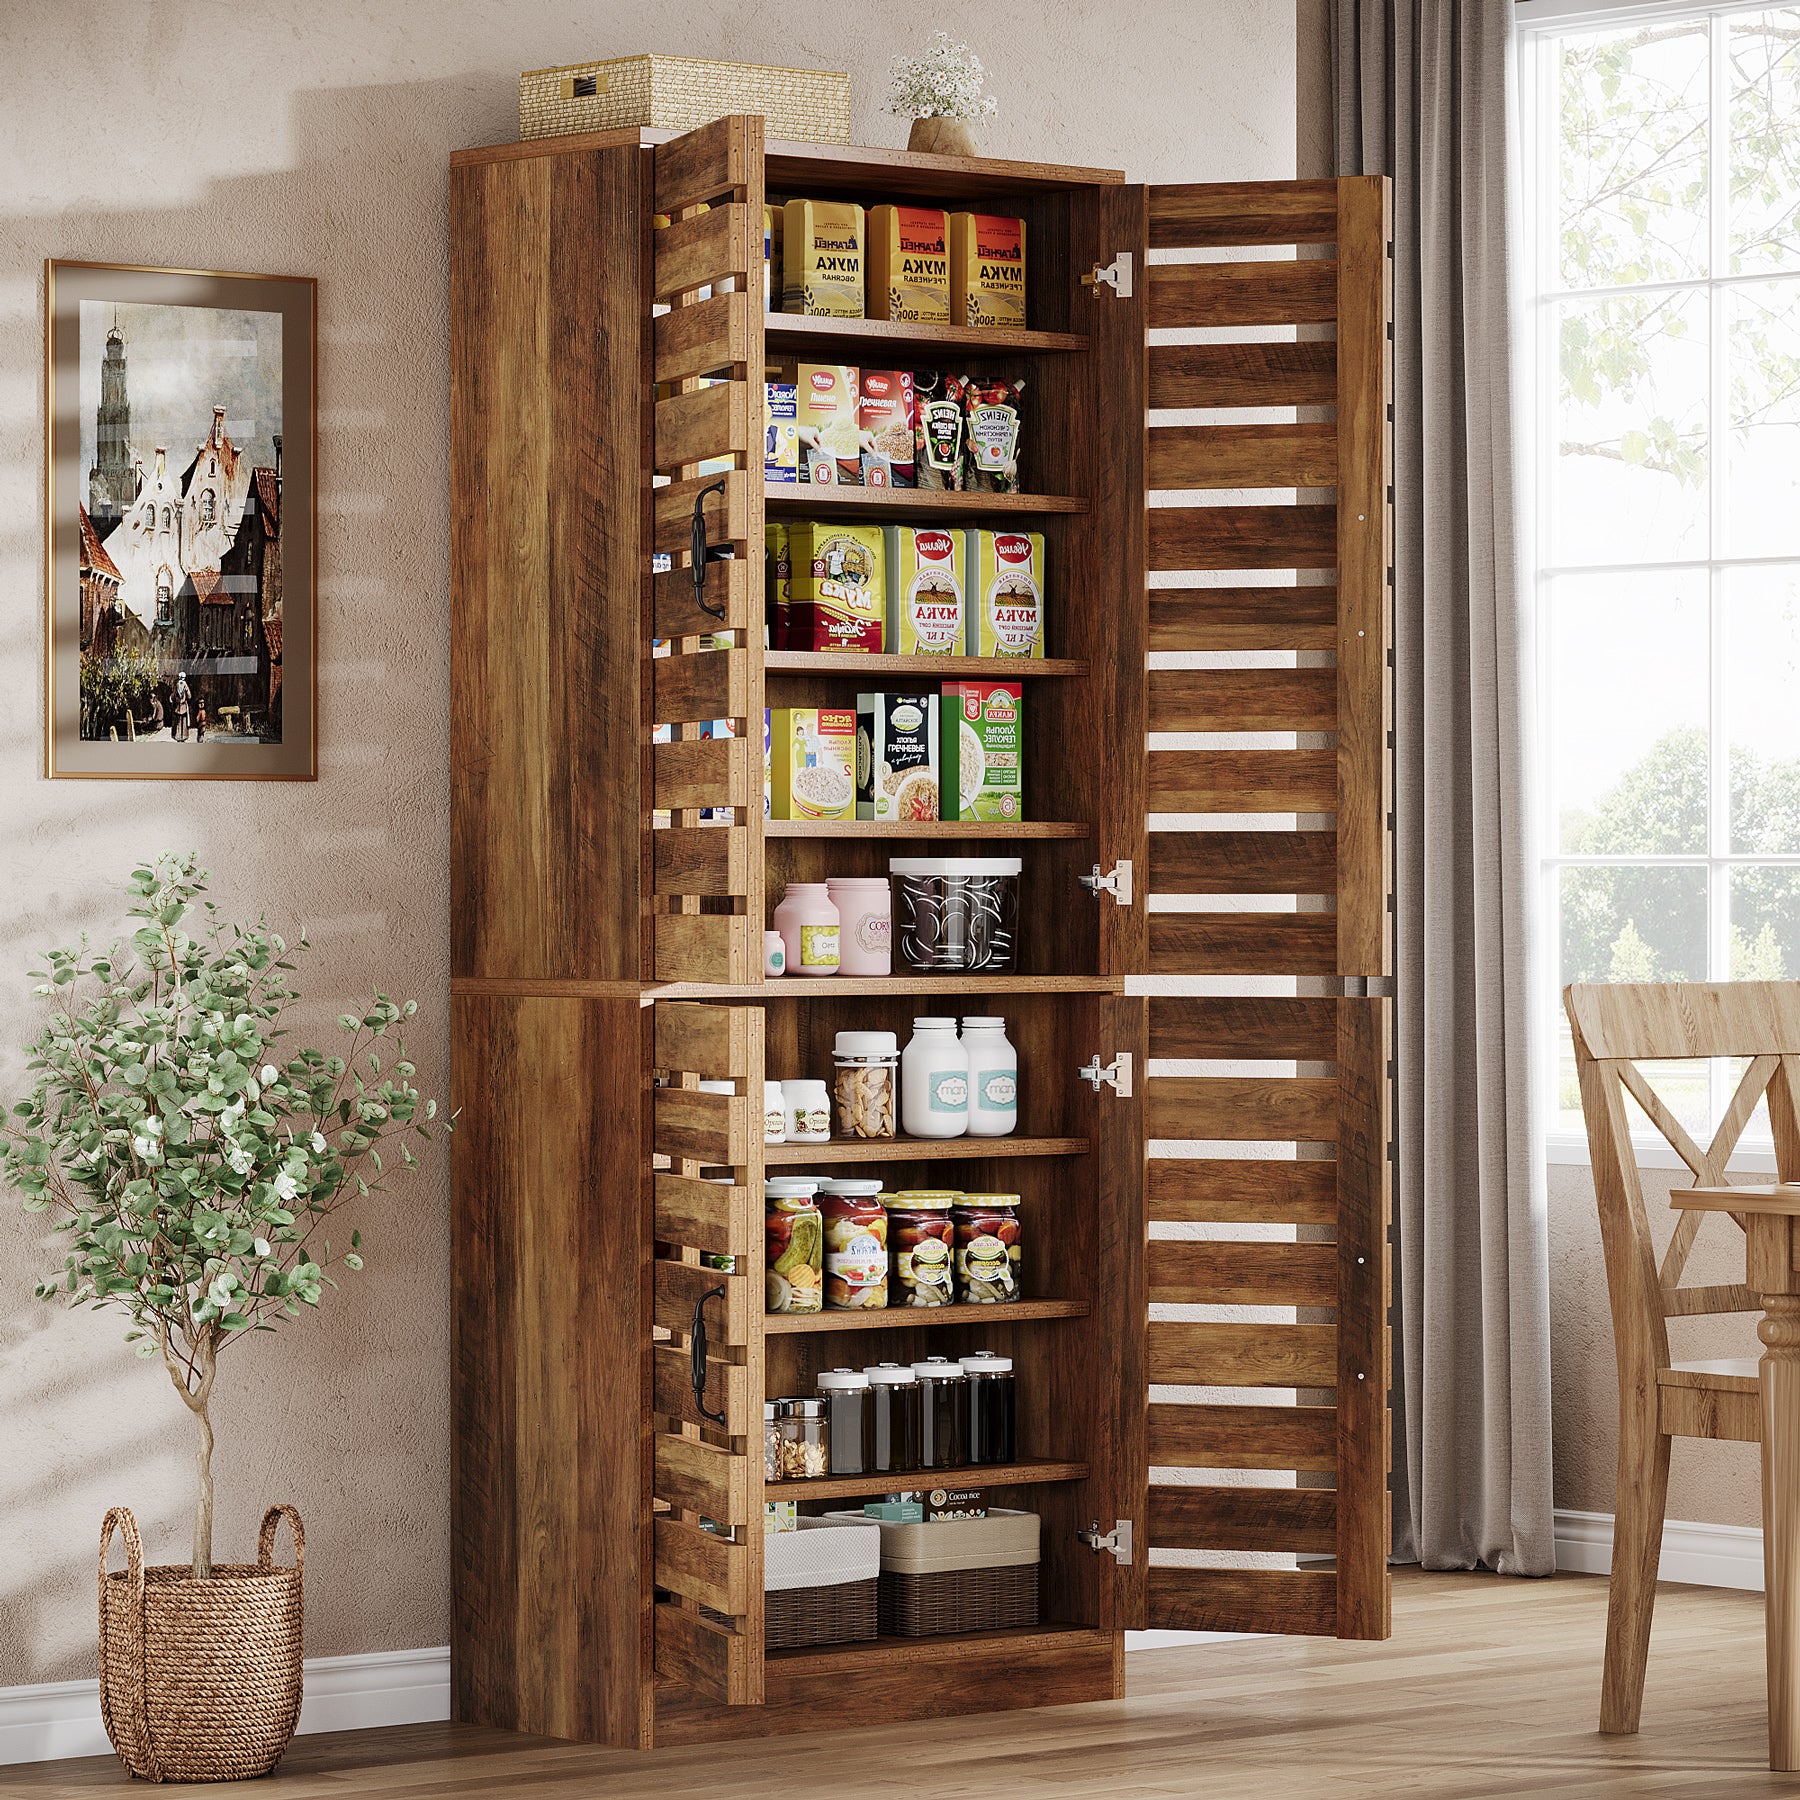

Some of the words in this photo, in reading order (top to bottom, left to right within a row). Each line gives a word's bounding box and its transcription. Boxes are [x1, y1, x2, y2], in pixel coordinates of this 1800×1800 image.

[896, 736, 918, 744] ХЛОПЬЯ
[887, 744, 926, 753] ГРЕЧНЕВЫЕ
[949, 1492, 968, 1501] Cocoa
[968, 1491, 980, 1499] rice
